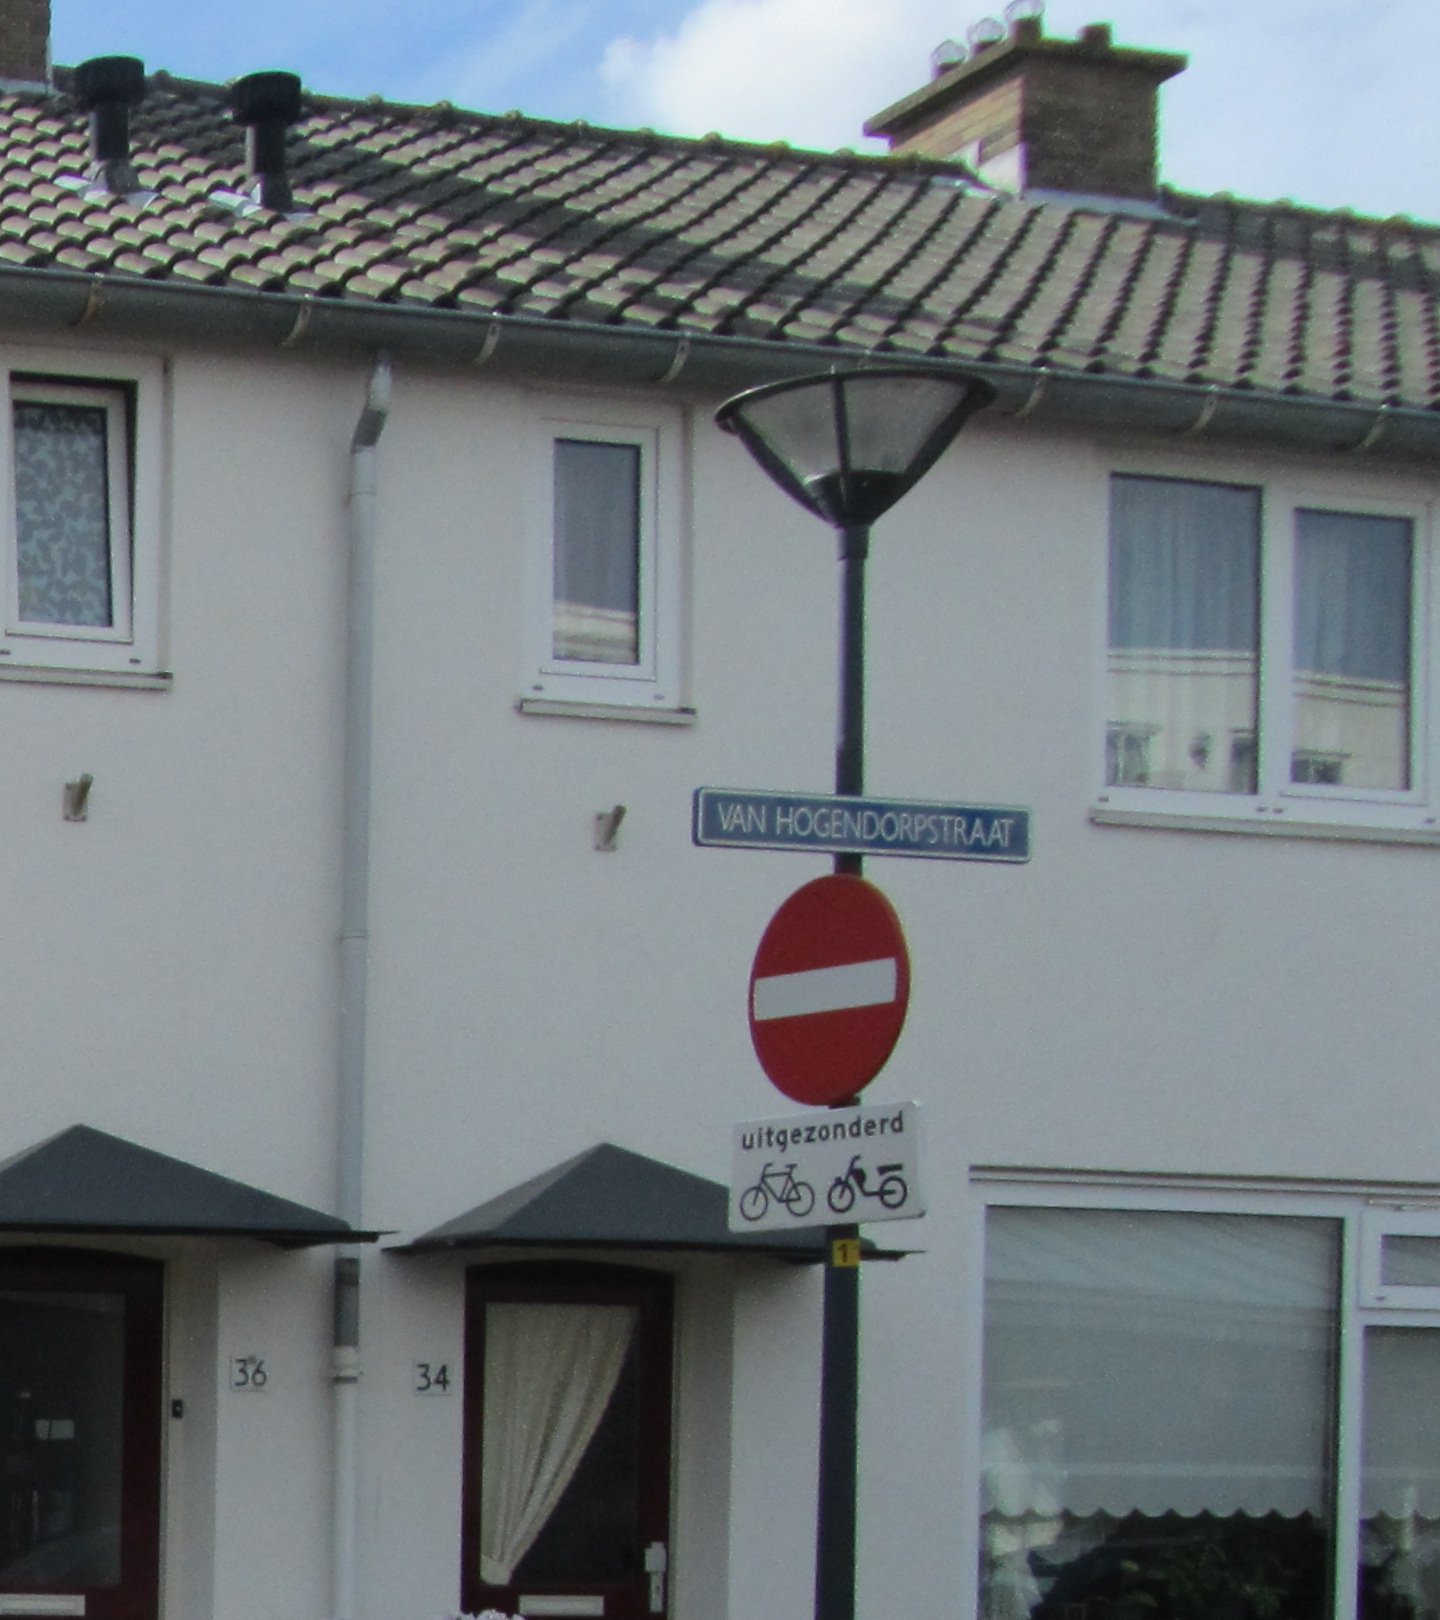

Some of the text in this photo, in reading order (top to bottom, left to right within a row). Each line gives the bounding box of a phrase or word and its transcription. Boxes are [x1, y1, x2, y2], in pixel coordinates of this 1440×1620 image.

[718, 802, 1014, 848] VAN HOGENDORPSTRAAT
[742, 1110, 904, 1152] uitgezonderd
[836, 1243, 850, 1263] 1
[234, 1357, 268, 1387] 36
[416, 1363, 451, 1391] 34
